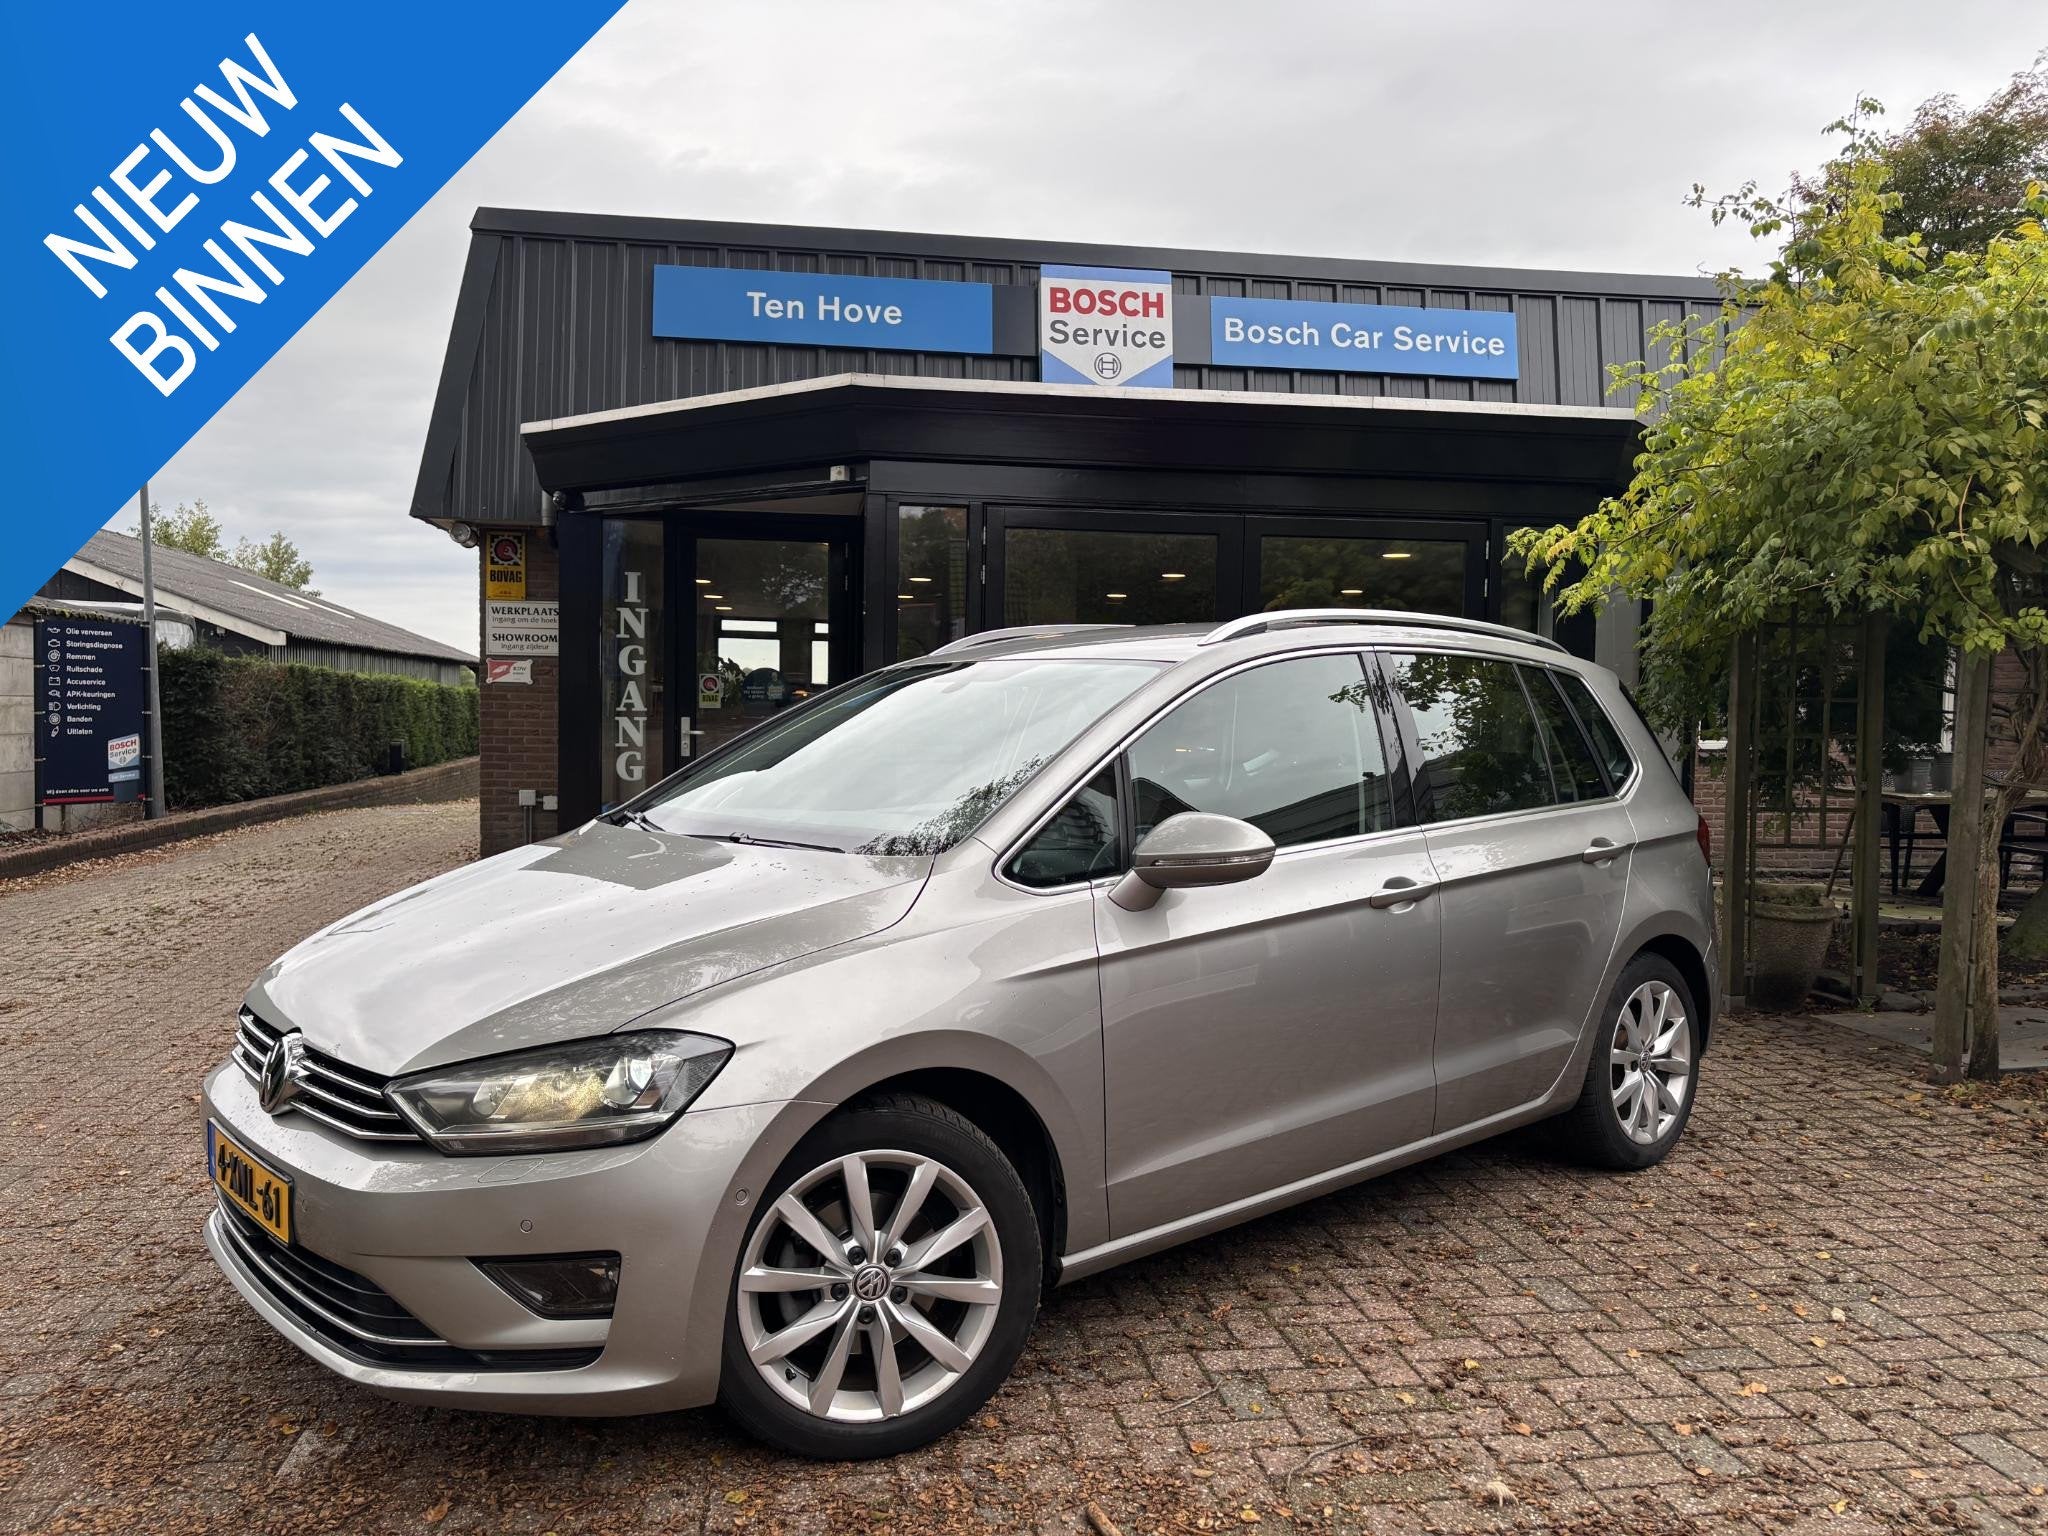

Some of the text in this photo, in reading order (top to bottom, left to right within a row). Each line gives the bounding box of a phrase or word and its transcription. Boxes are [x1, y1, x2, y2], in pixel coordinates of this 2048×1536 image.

[1049, 287, 1164, 318] BOSCH
[747, 291, 902, 325] Ten Hove
[1049, 319, 1166, 349] Service
[1224, 317, 1505, 356] Bosch Car Service
[490, 570, 522, 583] BOVAG
[491, 606, 559, 616] WERKPLAATS
[65, 627, 113, 637] Olie verversen
[492, 633, 558, 643] SHOWROOM
[66, 640, 123, 650] Storingsdiagnose
[66, 652, 96, 661] Remmen
[66, 665, 103, 673] Ruitschade
[614, 571, 649, 781] INGANG
[66, 678, 106, 686] Accuservice
[66, 690, 116, 699] APK-keuringen
[67, 702, 102, 711] Verlichting
[67, 715, 93, 723] Banden
[109, 739, 137, 751] BOSCH
[109, 748, 137, 759] Service
